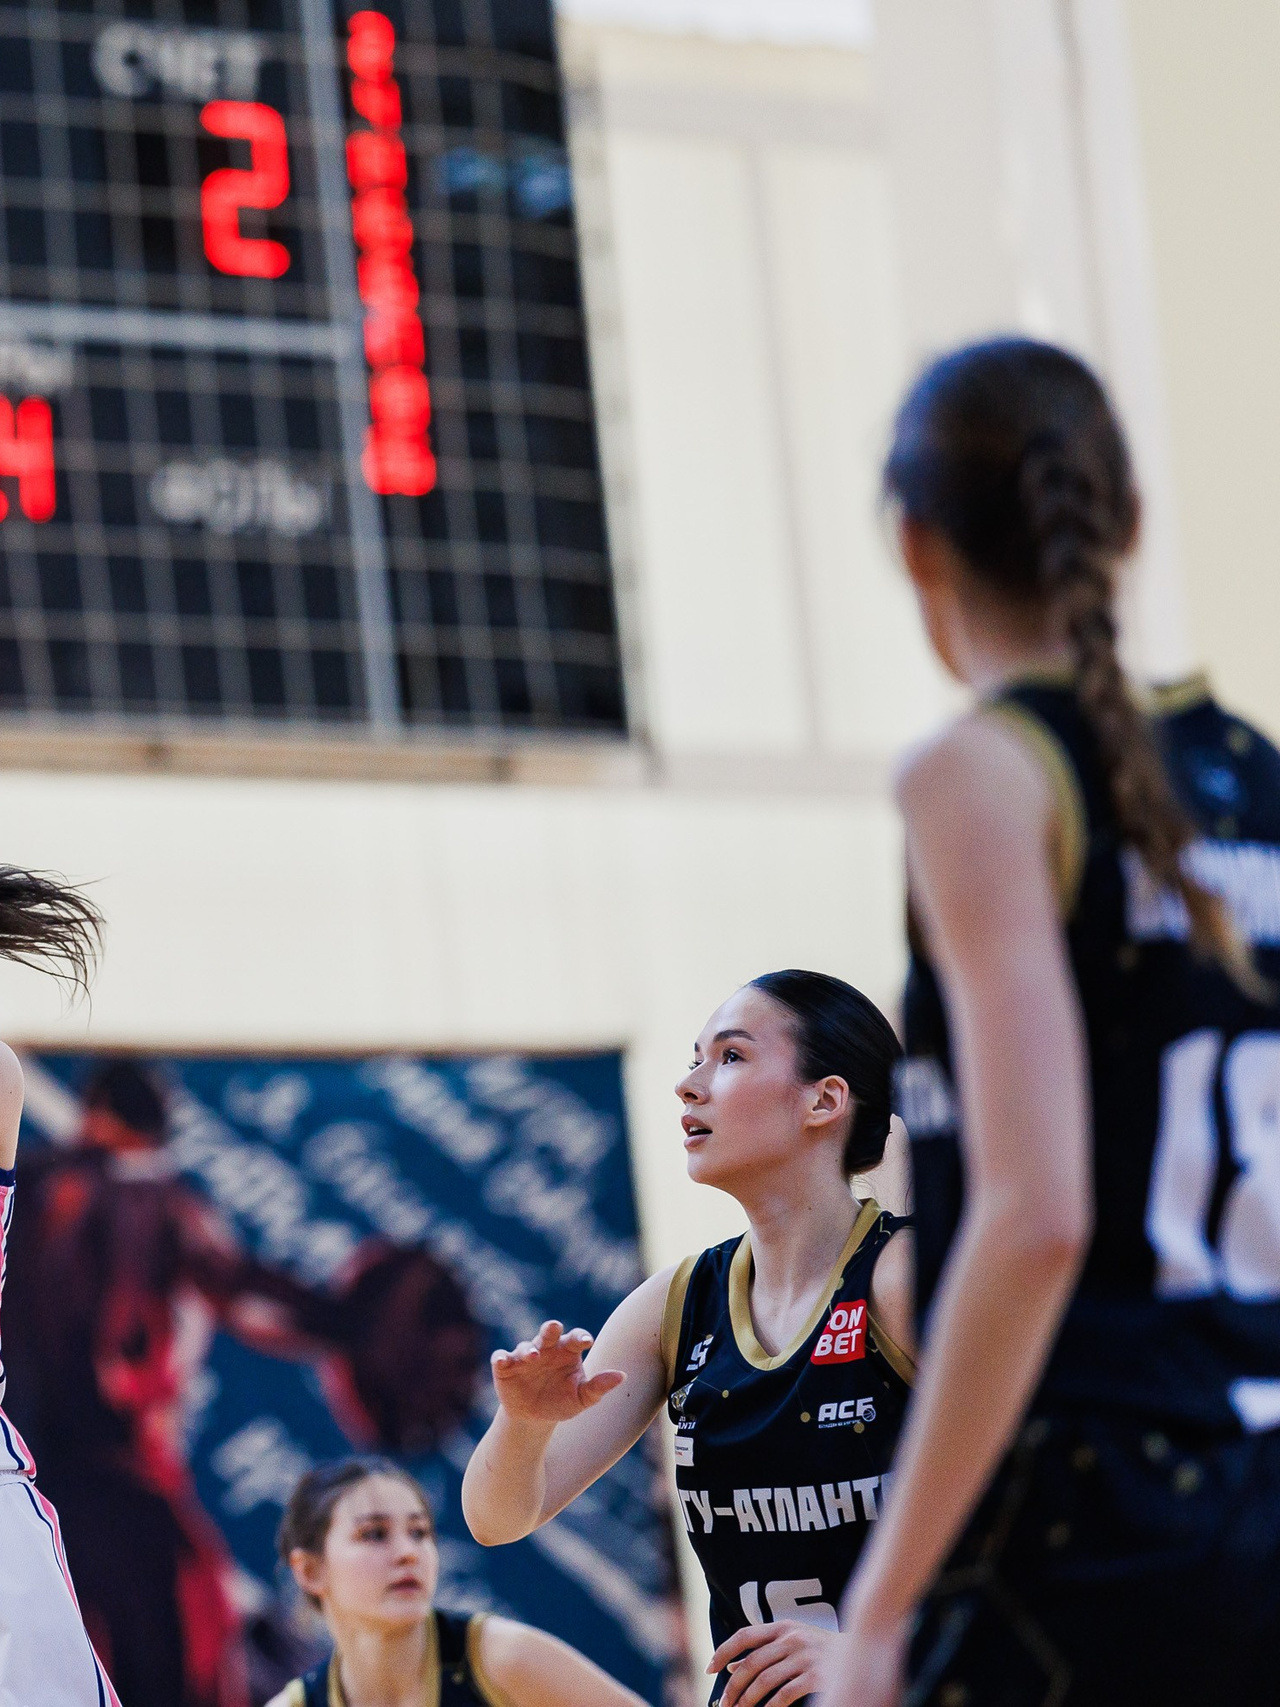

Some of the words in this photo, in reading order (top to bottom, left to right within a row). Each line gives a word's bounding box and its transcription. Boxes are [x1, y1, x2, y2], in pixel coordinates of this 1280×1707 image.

[200, 100, 290, 279] 2
[826, 1306, 864, 1331] ON
[814, 1328, 862, 1357] BET
[676, 1473, 894, 1534] ГУ-АТЛАНТ
